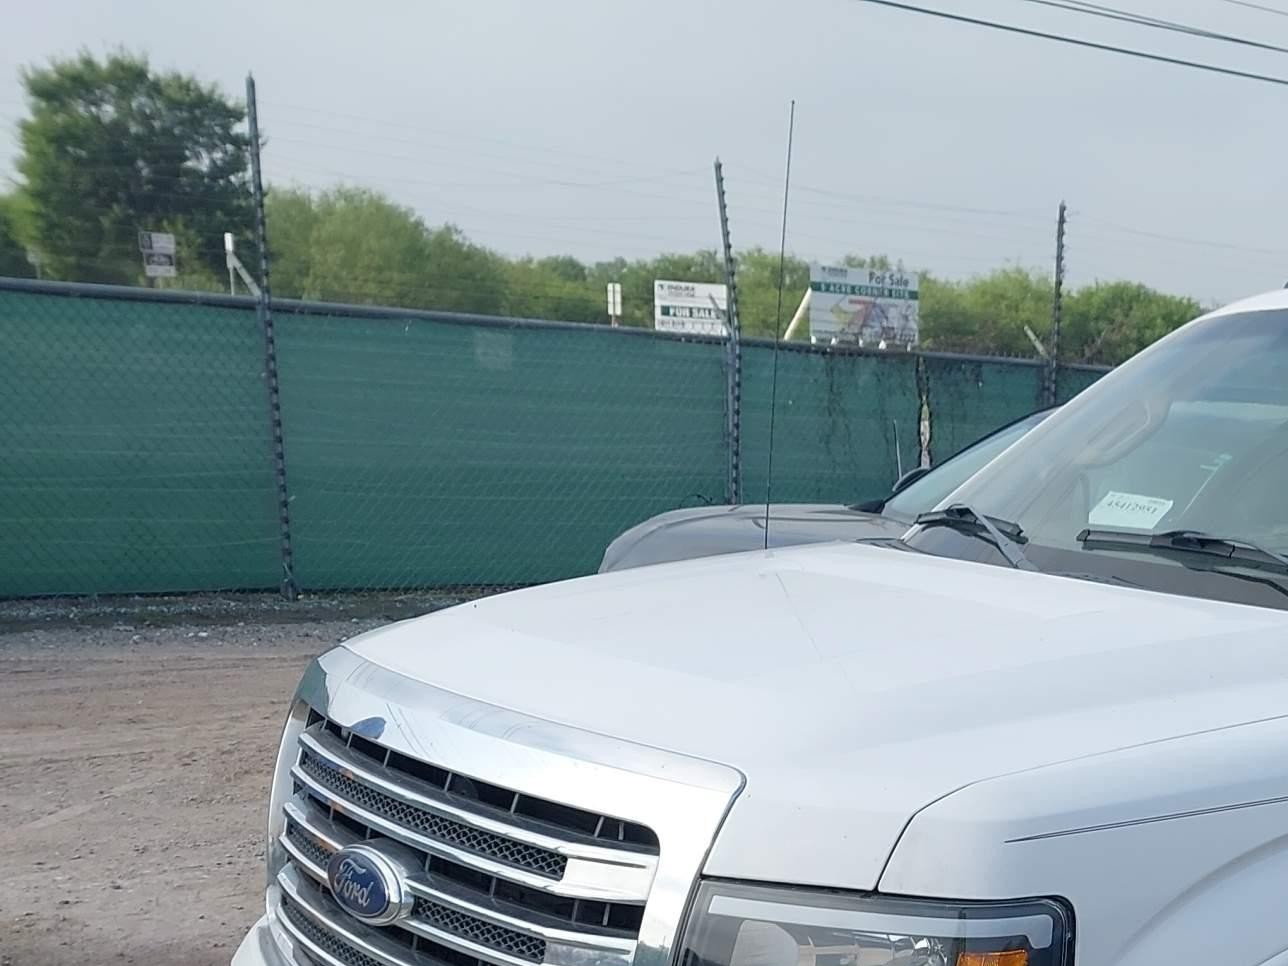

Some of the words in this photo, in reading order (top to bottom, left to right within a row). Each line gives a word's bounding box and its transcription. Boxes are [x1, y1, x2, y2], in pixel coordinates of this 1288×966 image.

[868, 271, 887, 286] For
[889, 273, 910, 288] Sale
[669, 305, 691, 318] FOR
[692, 307, 717, 320] SALE
[334, 858, 375, 907] Ford
